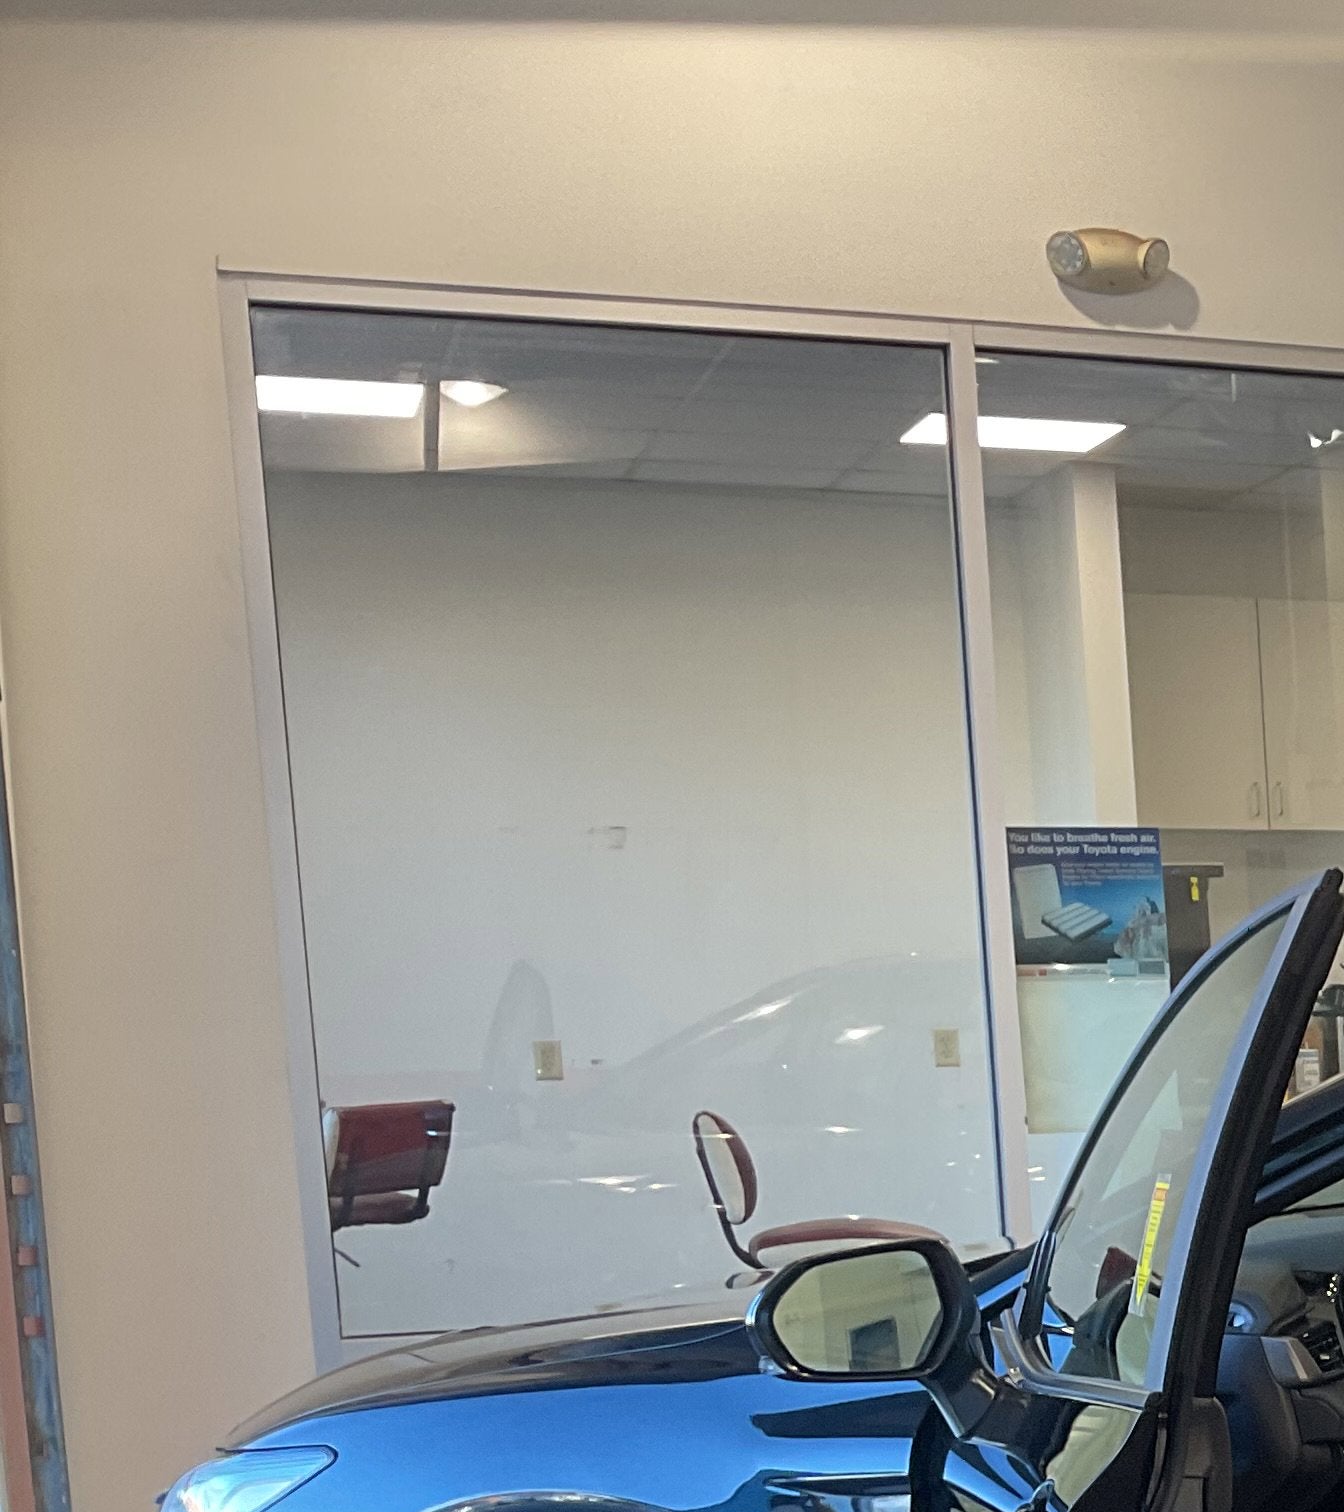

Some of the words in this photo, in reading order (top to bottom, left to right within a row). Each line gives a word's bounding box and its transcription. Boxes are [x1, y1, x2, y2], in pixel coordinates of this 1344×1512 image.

[1008, 832, 1029, 843] You
[1031, 832, 1050, 842] like
[1053, 833, 1064, 843] to
[1066, 832, 1108, 843] breathe
[1110, 832, 1138, 843] fresh
[1027, 845, 1054, 854] does
[1055, 846, 1080, 857] your
[1083, 844, 1118, 857] Toyota
[1120, 846, 1159, 856] engine.
